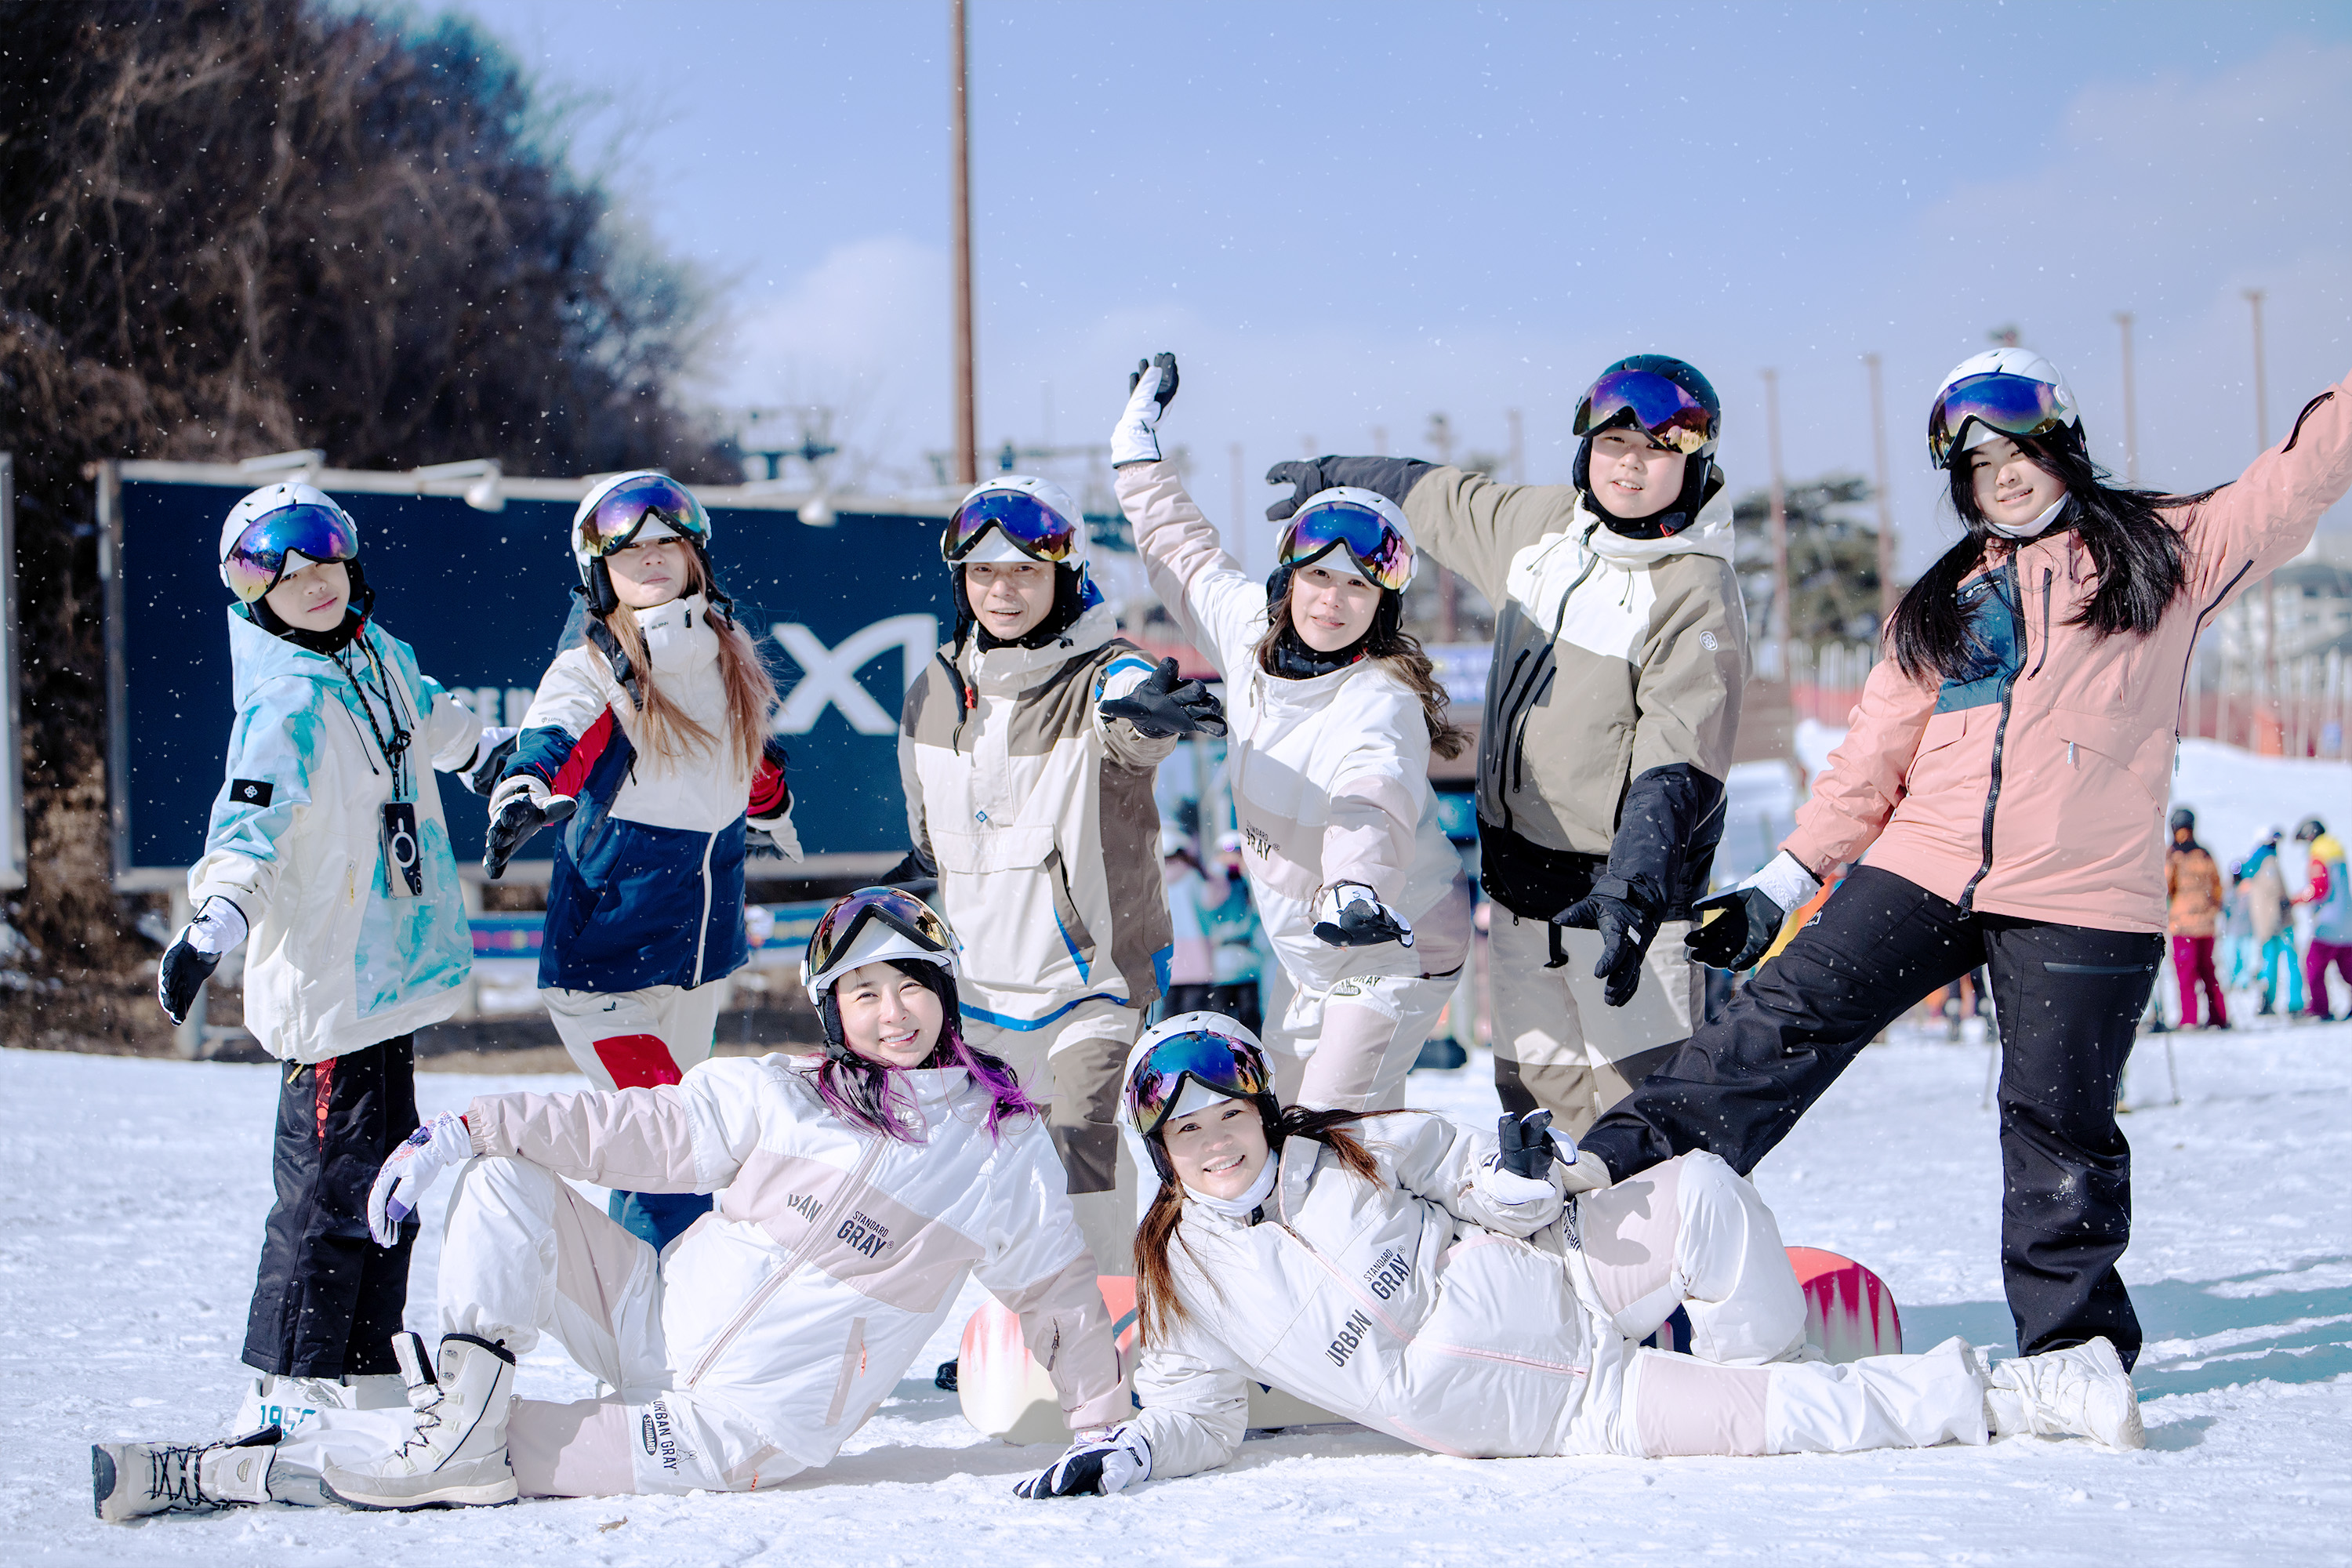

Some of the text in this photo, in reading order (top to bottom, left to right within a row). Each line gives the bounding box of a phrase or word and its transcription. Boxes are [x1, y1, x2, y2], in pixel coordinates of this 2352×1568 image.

[837, 1220, 887, 1258] GRAY
[852, 1210, 889, 1238] STANDARD
[1363, 1248, 1393, 1282] STANDARD
[1371, 1254, 1410, 1300] GRAY
[1325, 1308, 1372, 1367] URBAN
[643, 1416, 656, 1451] STANDARD
[653, 1400, 677, 1470] URBAN GRAY
